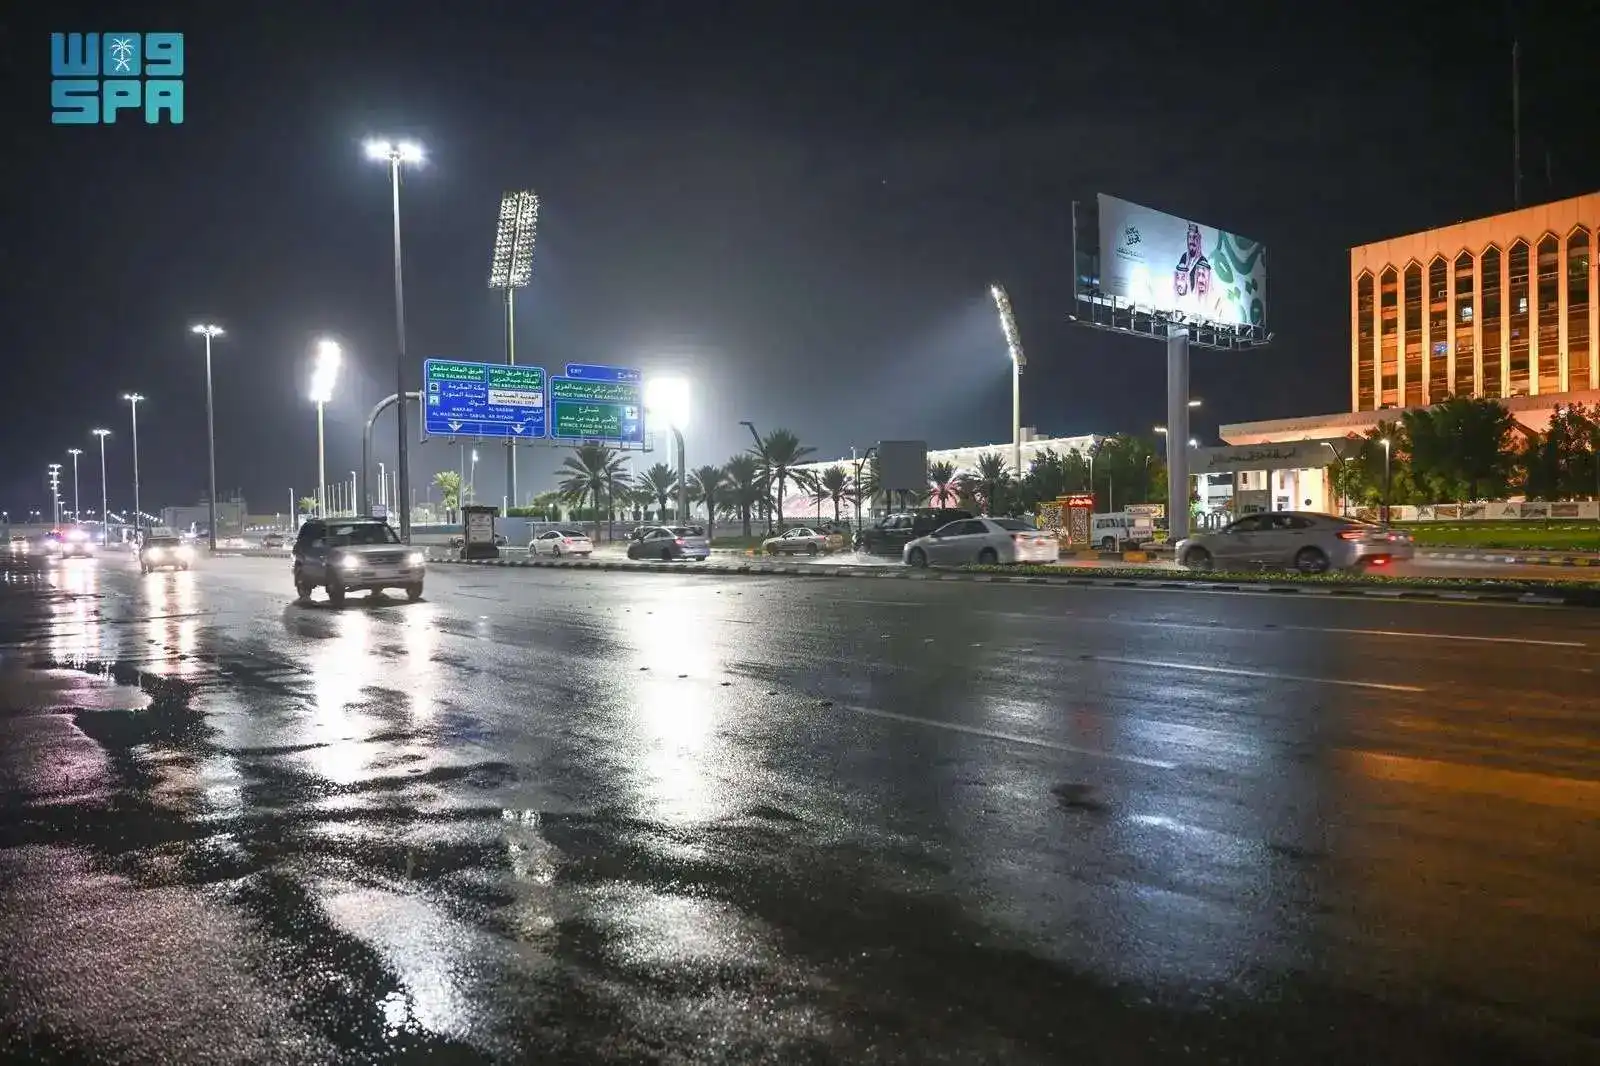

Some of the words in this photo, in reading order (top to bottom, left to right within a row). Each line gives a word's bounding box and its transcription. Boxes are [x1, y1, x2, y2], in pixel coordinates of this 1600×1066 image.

[429, 364, 449, 372] سلمان
[450, 365, 468, 373] الملك
[468, 367, 484, 375] طريق
[448, 383, 473, 391] المكرمة
[554, 382, 583, 391] عبدالعزيز
[465, 391, 486, 399] المدينة
[493, 391, 519, 399] الصناعية
[468, 399, 486, 407] تبوك
[579, 406, 599, 414] شارع
[601, 415, 618, 424] الأمير
